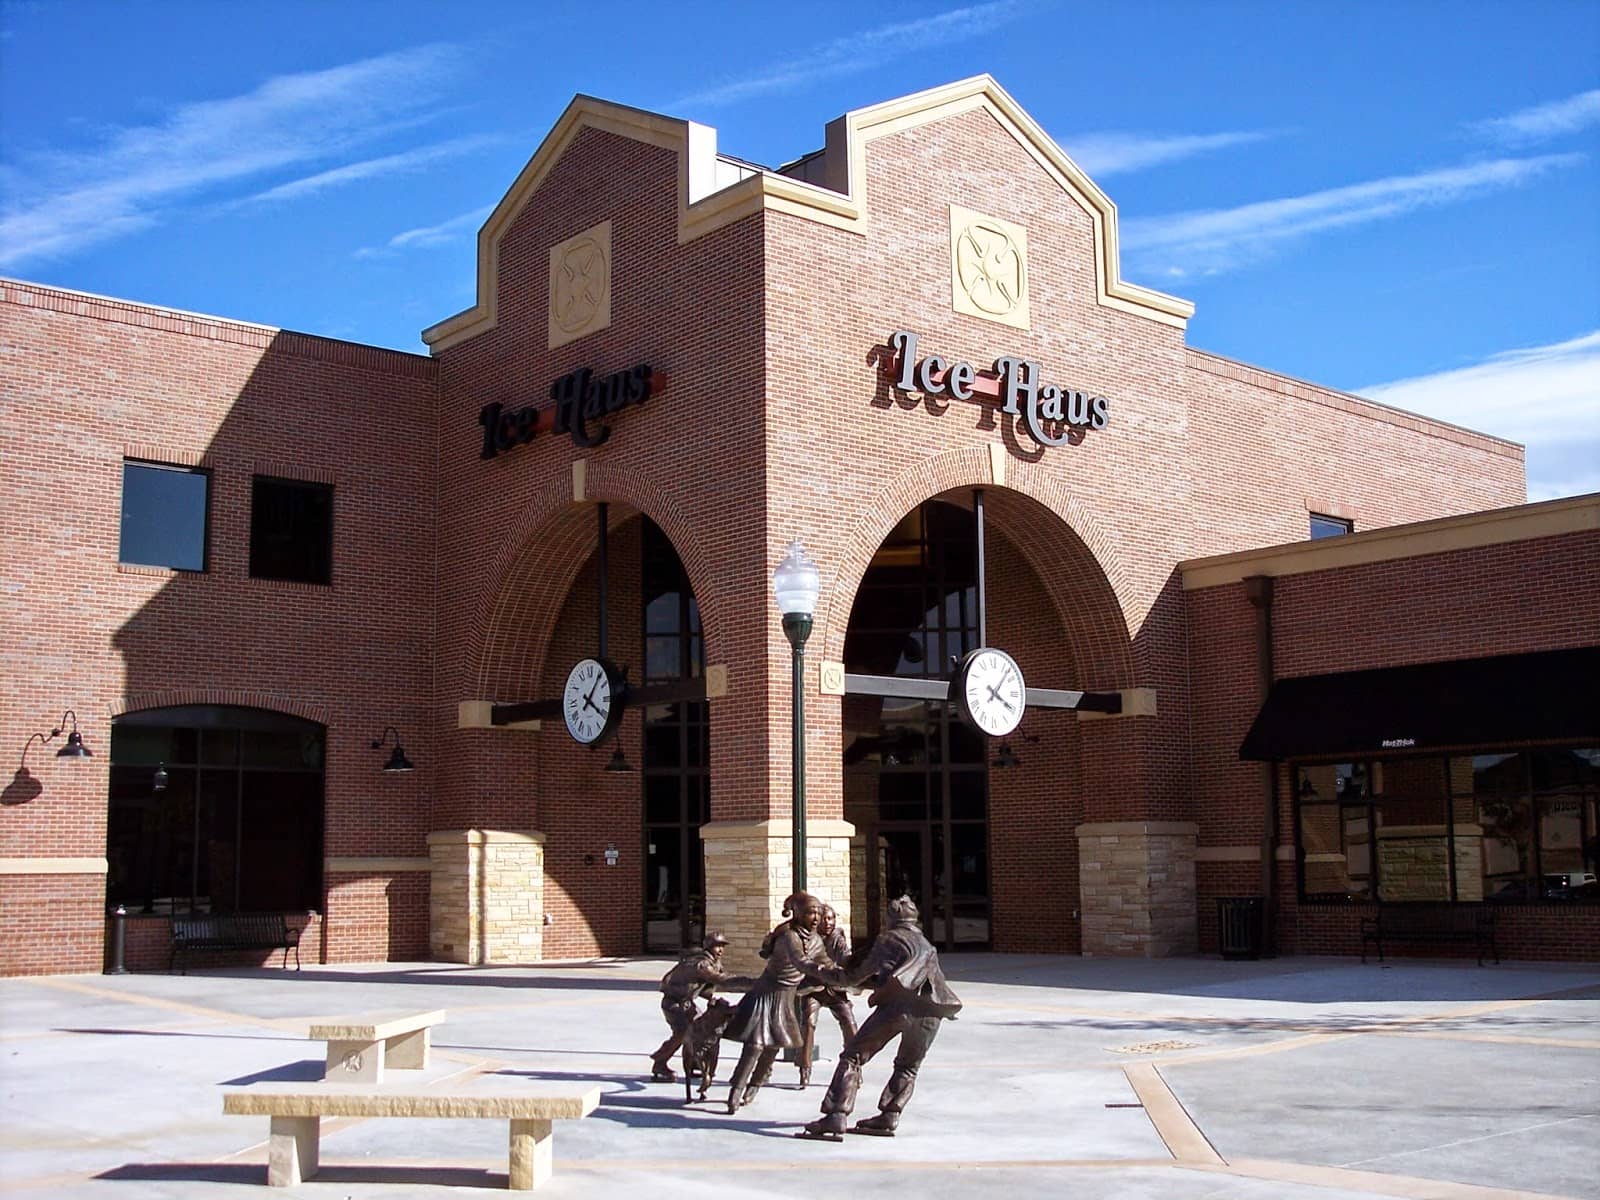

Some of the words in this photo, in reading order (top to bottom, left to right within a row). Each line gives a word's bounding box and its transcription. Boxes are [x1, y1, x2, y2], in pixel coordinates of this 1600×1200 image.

[479, 402, 538, 460] Ice
[551, 363, 651, 448] Haus
[889, 330, 976, 399] Ice
[992, 355, 1110, 447] Haus
